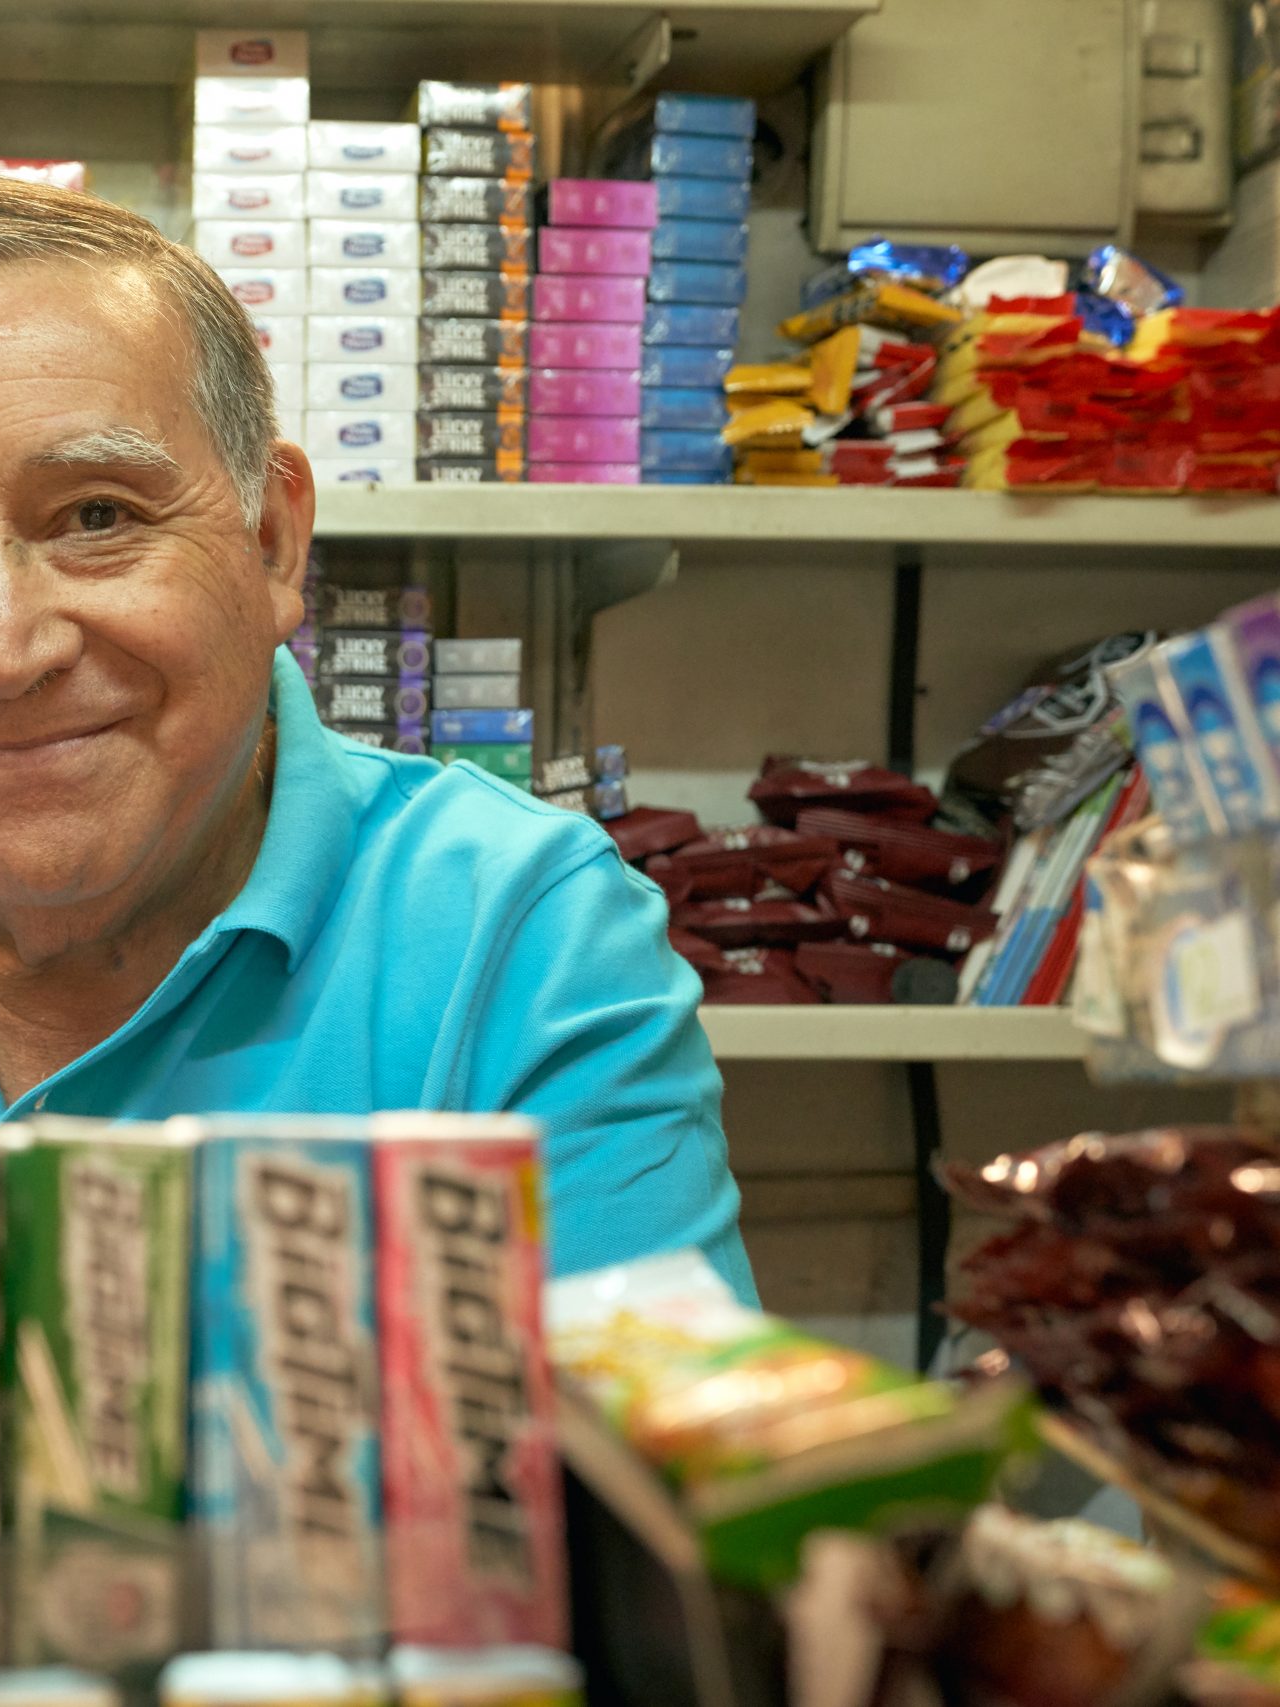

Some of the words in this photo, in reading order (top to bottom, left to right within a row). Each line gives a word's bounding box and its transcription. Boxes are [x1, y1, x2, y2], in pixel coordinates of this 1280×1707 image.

[433, 372, 485, 389] LUCKY
[430, 389, 486, 407] STRIKE
[432, 418, 483, 435] LUCKY
[429, 435, 485, 453] STRIKE
[335, 638, 388, 654] LUCKY
[332, 655, 388, 674] STRIKE
[333, 685, 385, 701] LUCKY
[330, 701, 386, 721] STRIKE
